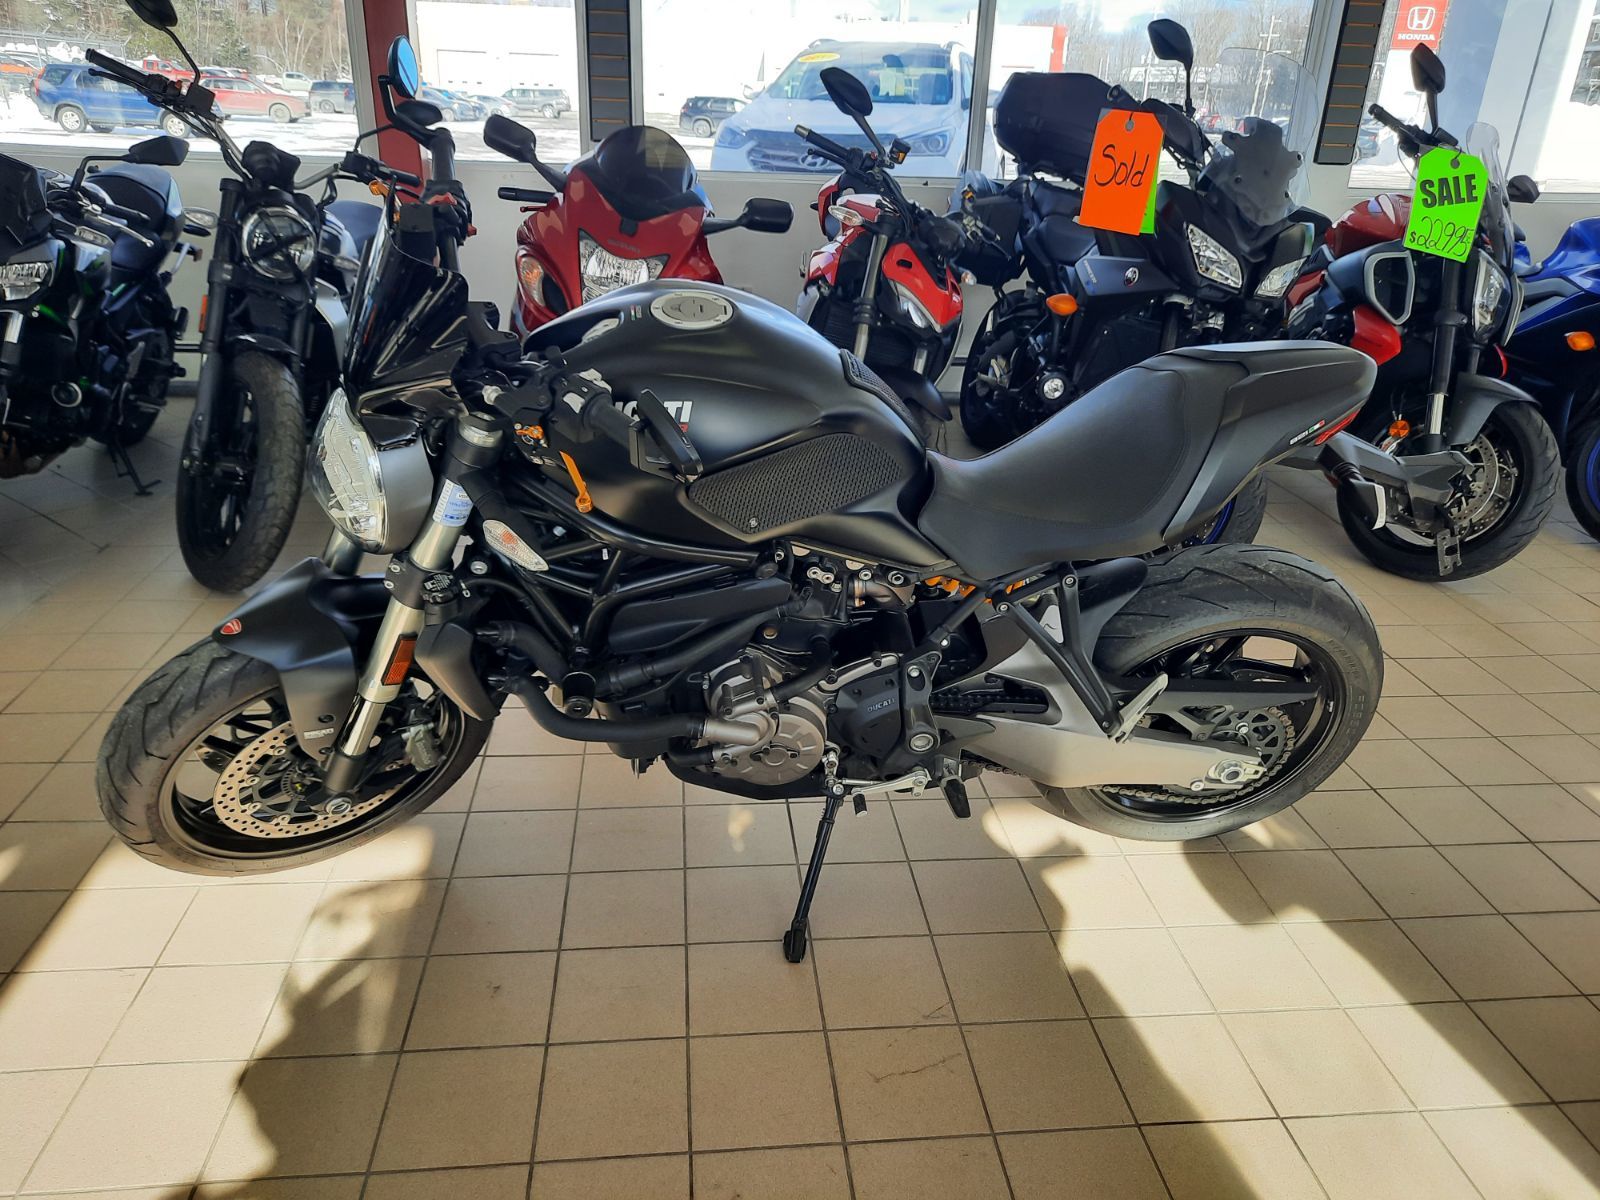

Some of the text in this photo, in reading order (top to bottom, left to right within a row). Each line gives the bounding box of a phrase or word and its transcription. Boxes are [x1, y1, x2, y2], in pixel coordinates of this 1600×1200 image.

[1398, 33, 1436, 41] HONDA
[1094, 144, 1149, 187] Sold
[1420, 173, 1478, 208] SALE
[867, 697, 895, 712] DUCATI
